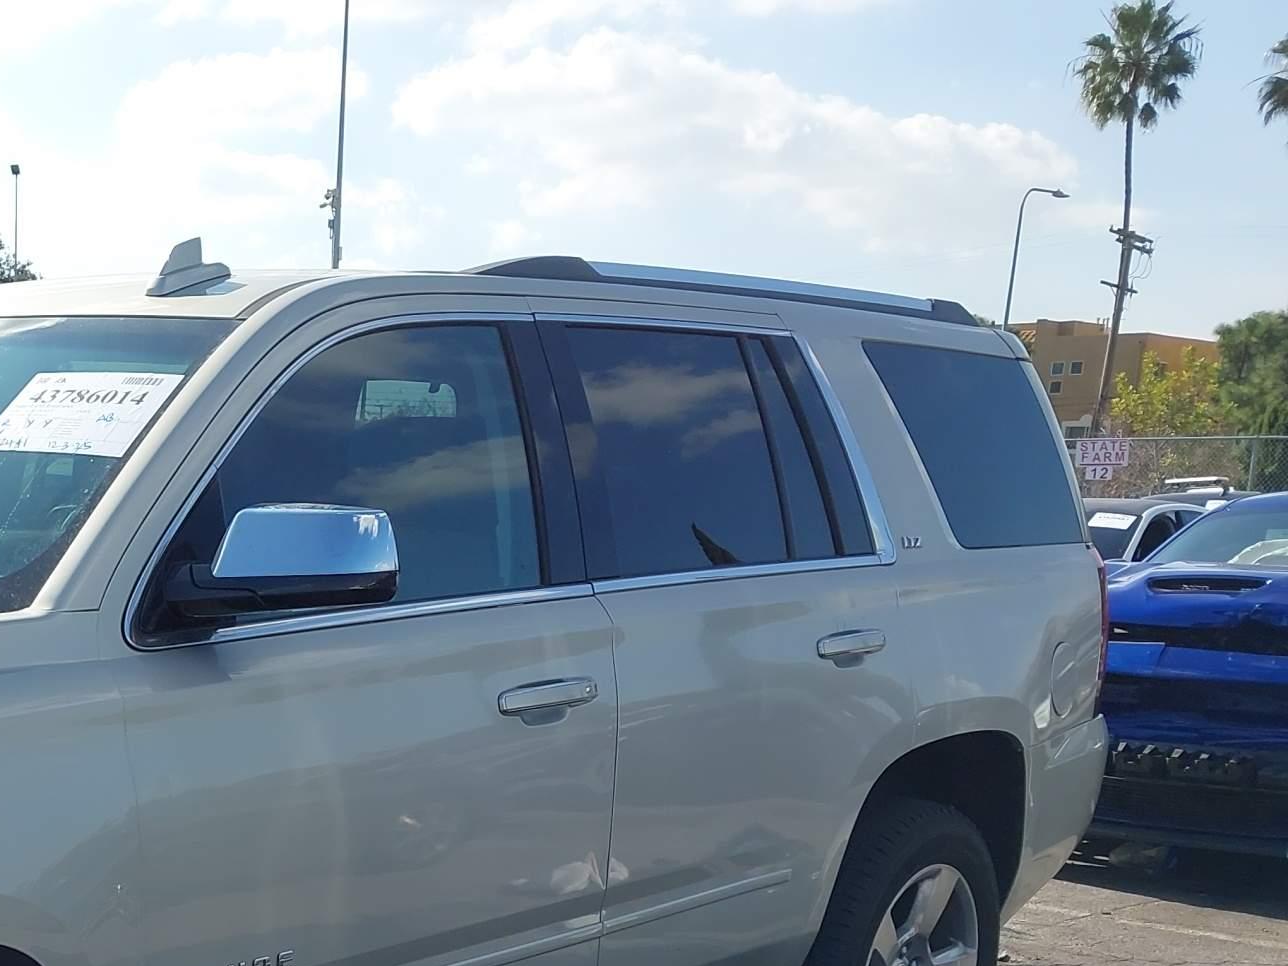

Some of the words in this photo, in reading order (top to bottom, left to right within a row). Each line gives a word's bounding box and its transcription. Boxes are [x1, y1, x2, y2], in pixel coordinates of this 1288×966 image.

[30, 389, 146, 405] 43786014
[1080, 441, 1127, 452] STATE
[1081, 452, 1125, 462] FARM
[1090, 467, 1109, 479] 12
